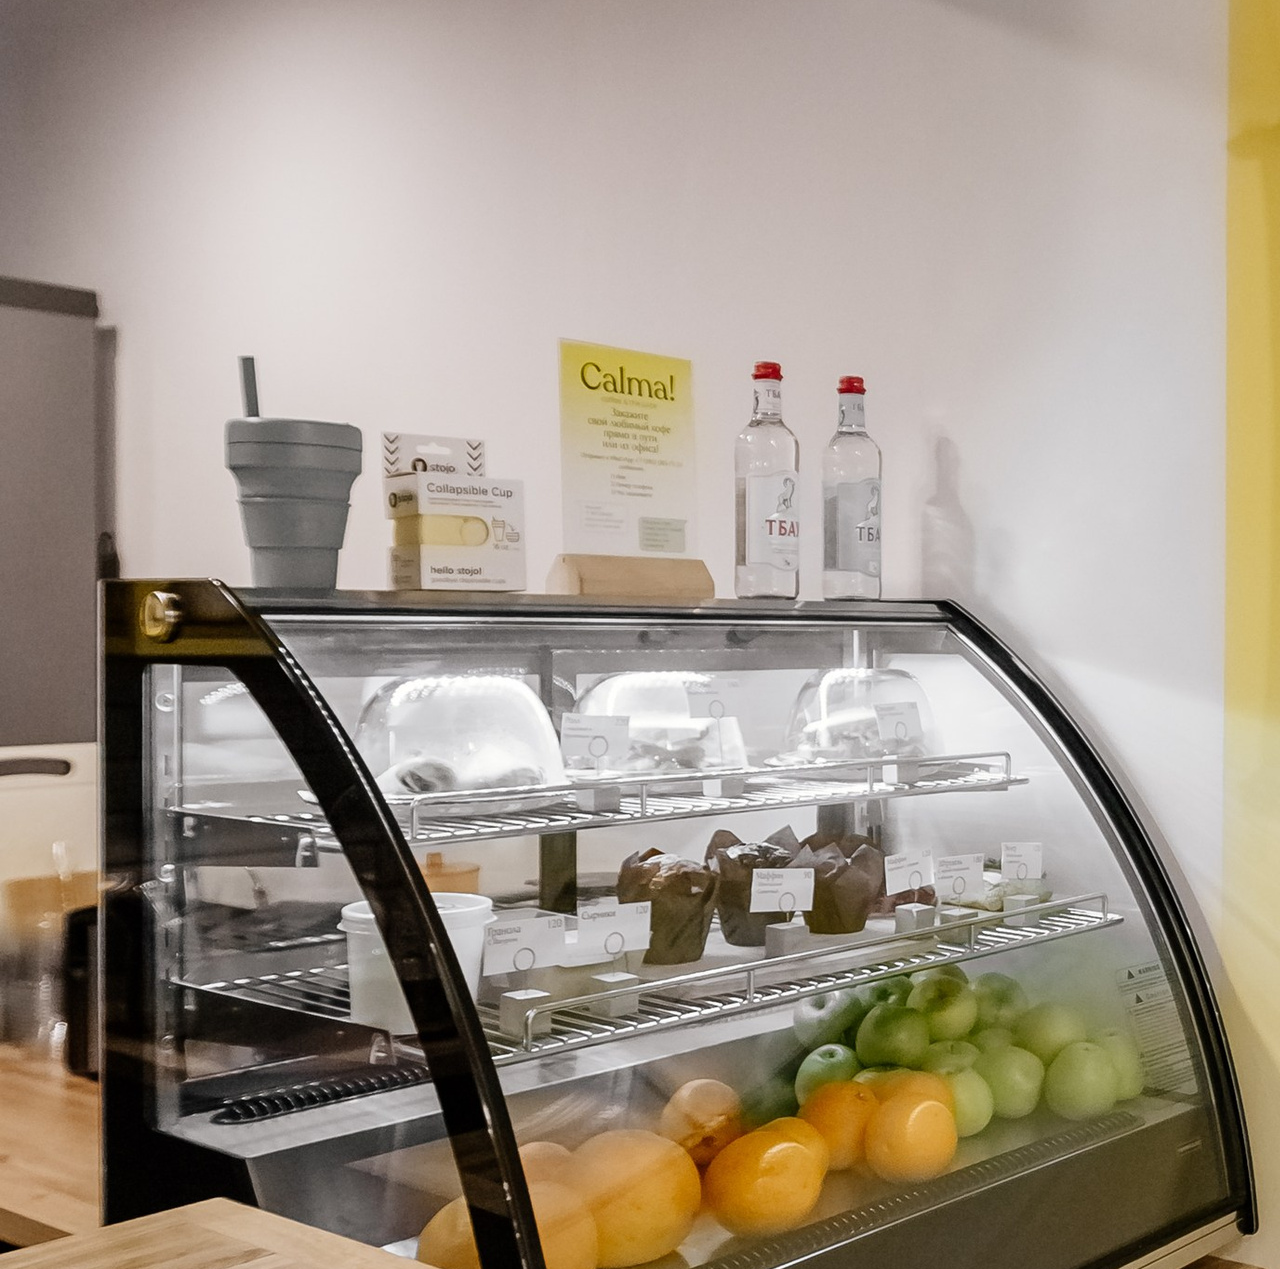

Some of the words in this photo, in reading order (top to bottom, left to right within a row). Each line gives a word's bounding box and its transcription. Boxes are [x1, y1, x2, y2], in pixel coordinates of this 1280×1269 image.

[580, 362, 675, 402] Calma!
[426, 482, 488, 497] Collapsible
[492, 487, 513, 498] Cup
[430, 566, 454, 575] hello
